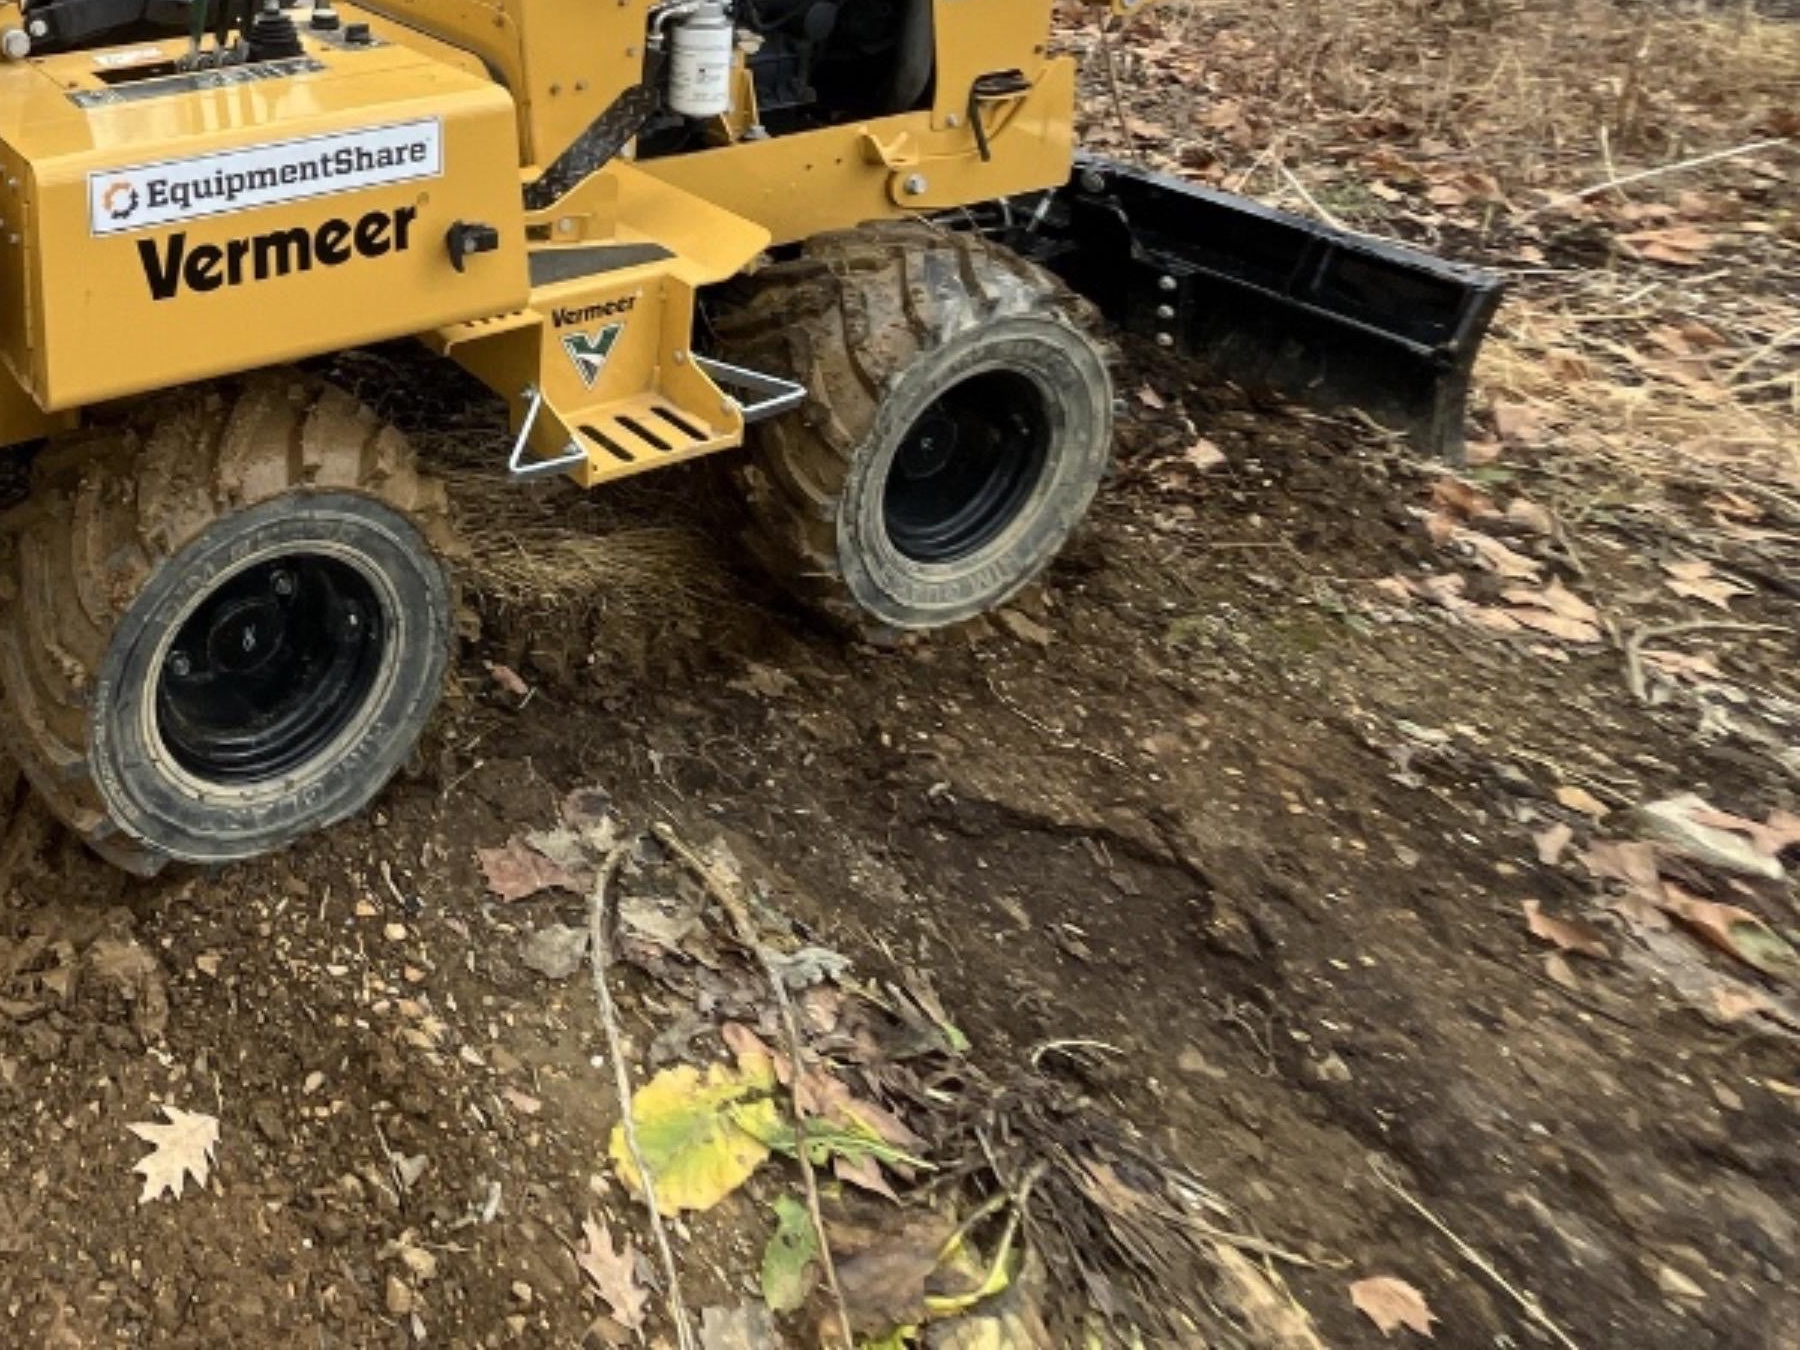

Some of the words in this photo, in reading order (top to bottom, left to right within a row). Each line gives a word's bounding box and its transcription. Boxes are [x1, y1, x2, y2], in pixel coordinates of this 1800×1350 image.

[146, 140, 428, 209] EquipmentShare
[137, 205, 417, 301] Vermeer
[551, 296, 636, 328] Vermeer
